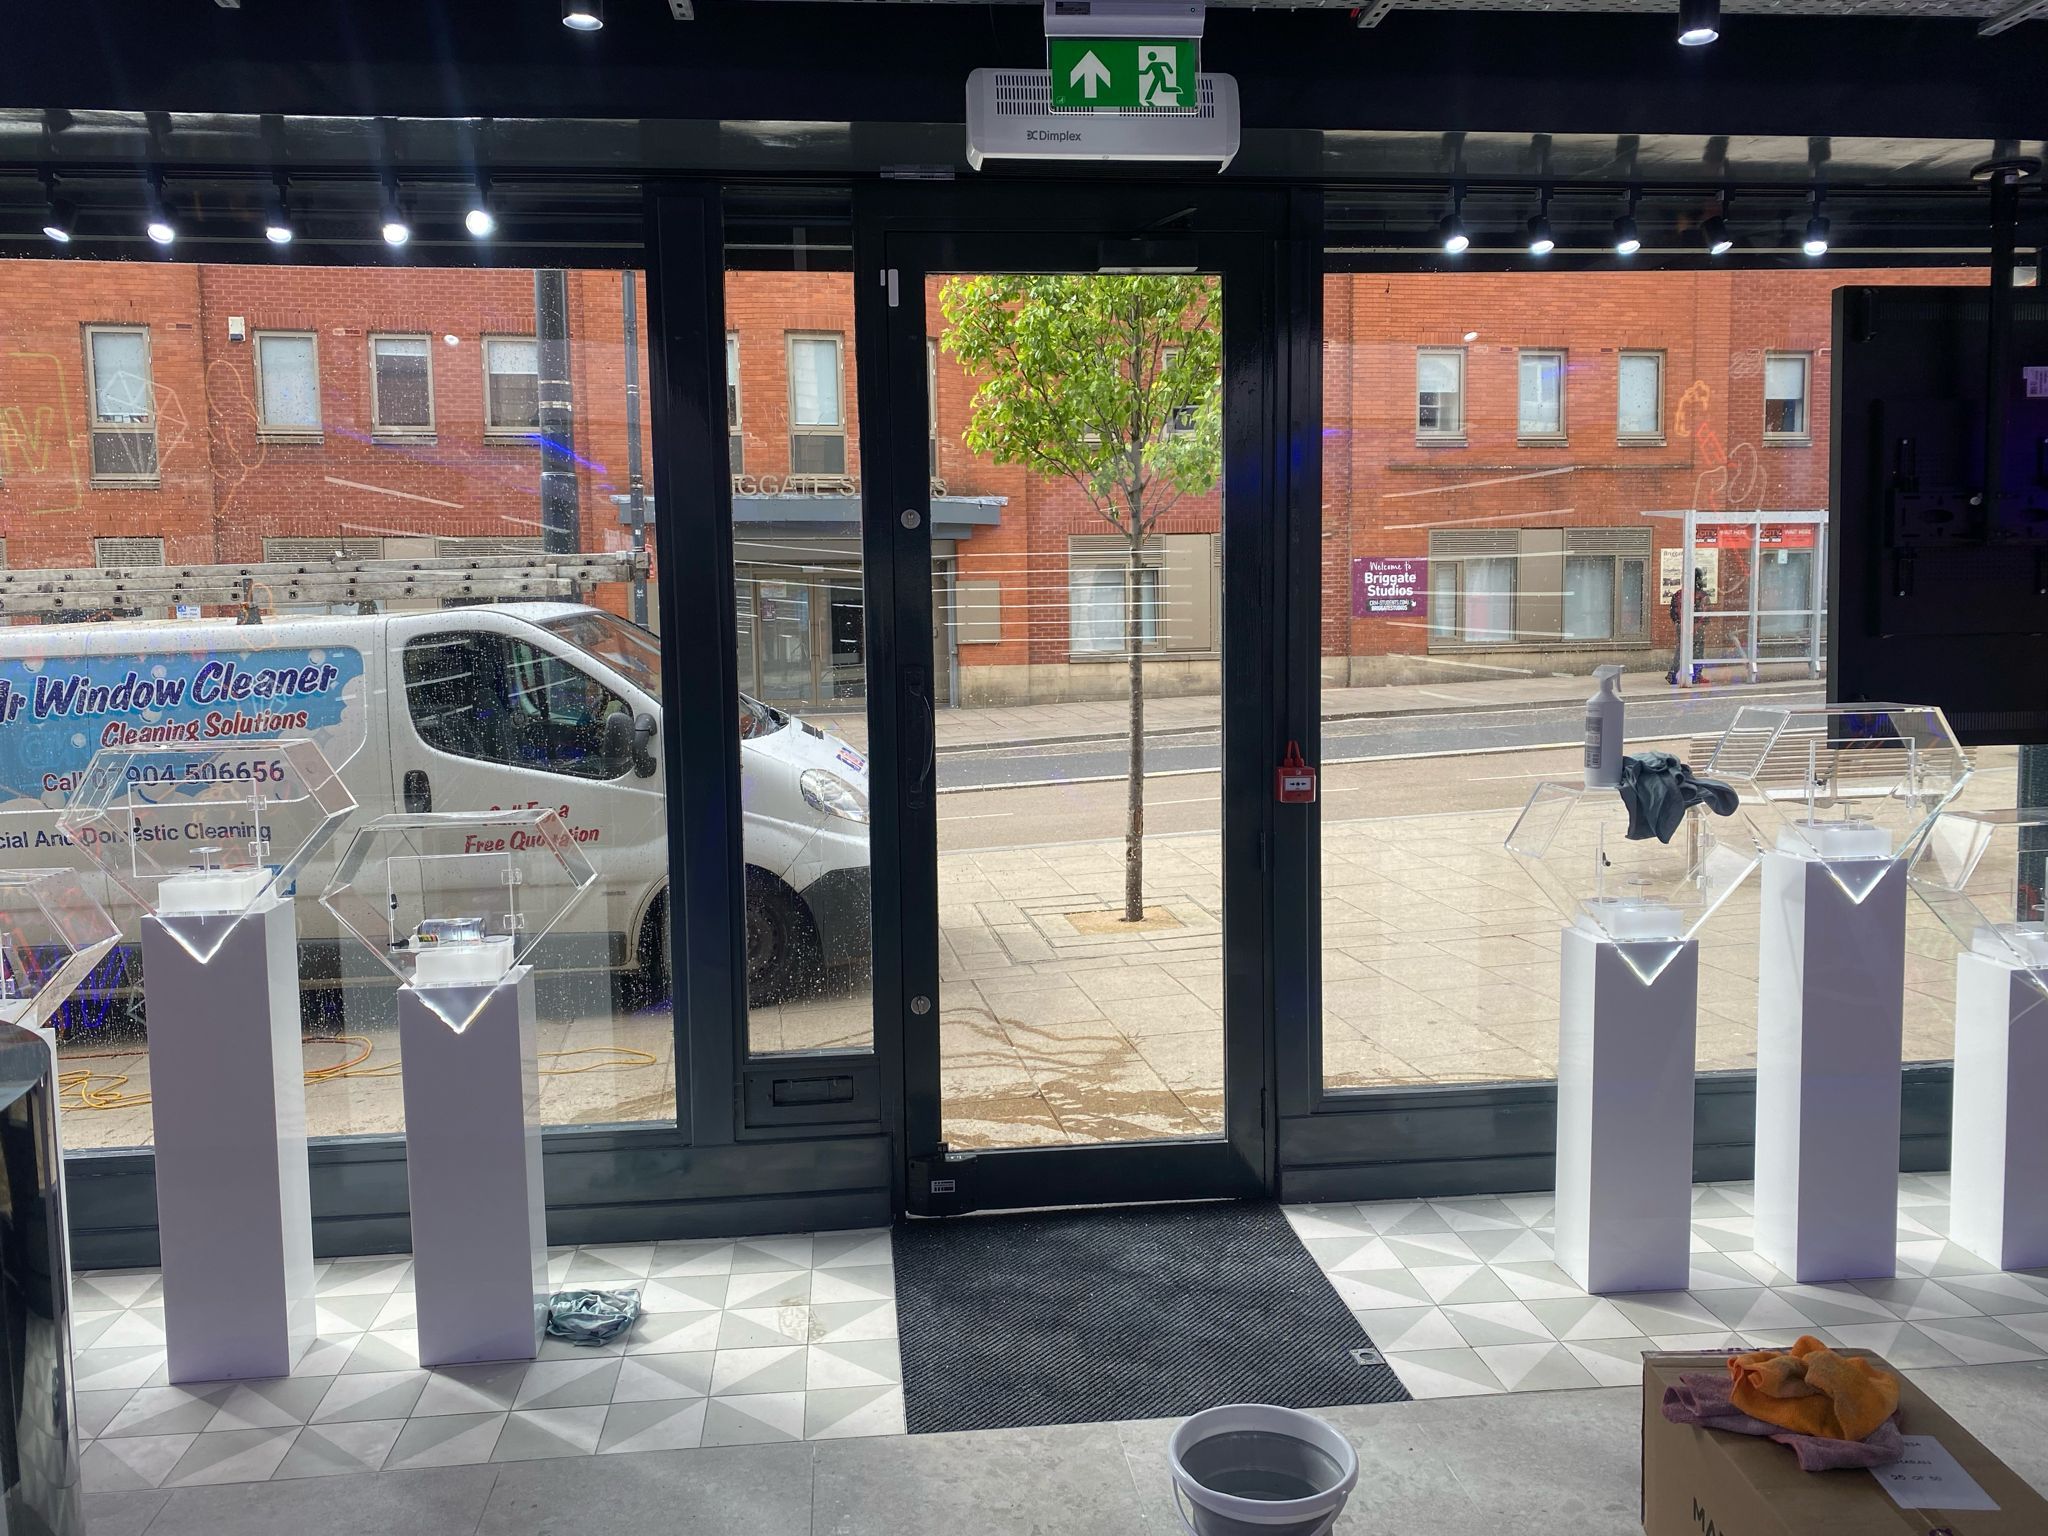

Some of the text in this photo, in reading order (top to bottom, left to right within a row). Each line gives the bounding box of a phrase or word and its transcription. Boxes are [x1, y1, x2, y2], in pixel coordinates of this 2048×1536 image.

[1039, 130, 1081, 142] Dimplex
[1369, 560, 1411, 571] Welcome to
[1364, 572, 1417, 586] Briggate
[1367, 584, 1414, 597] Studios
[35, 671, 188, 719] Window
[193, 660, 338, 704] Cleaner
[101, 710, 309, 748] Cleaning Solutions
[184, 760, 286, 785] 506656
[184, 821, 271, 842] Cleaning
[464, 834, 505, 853] Free
